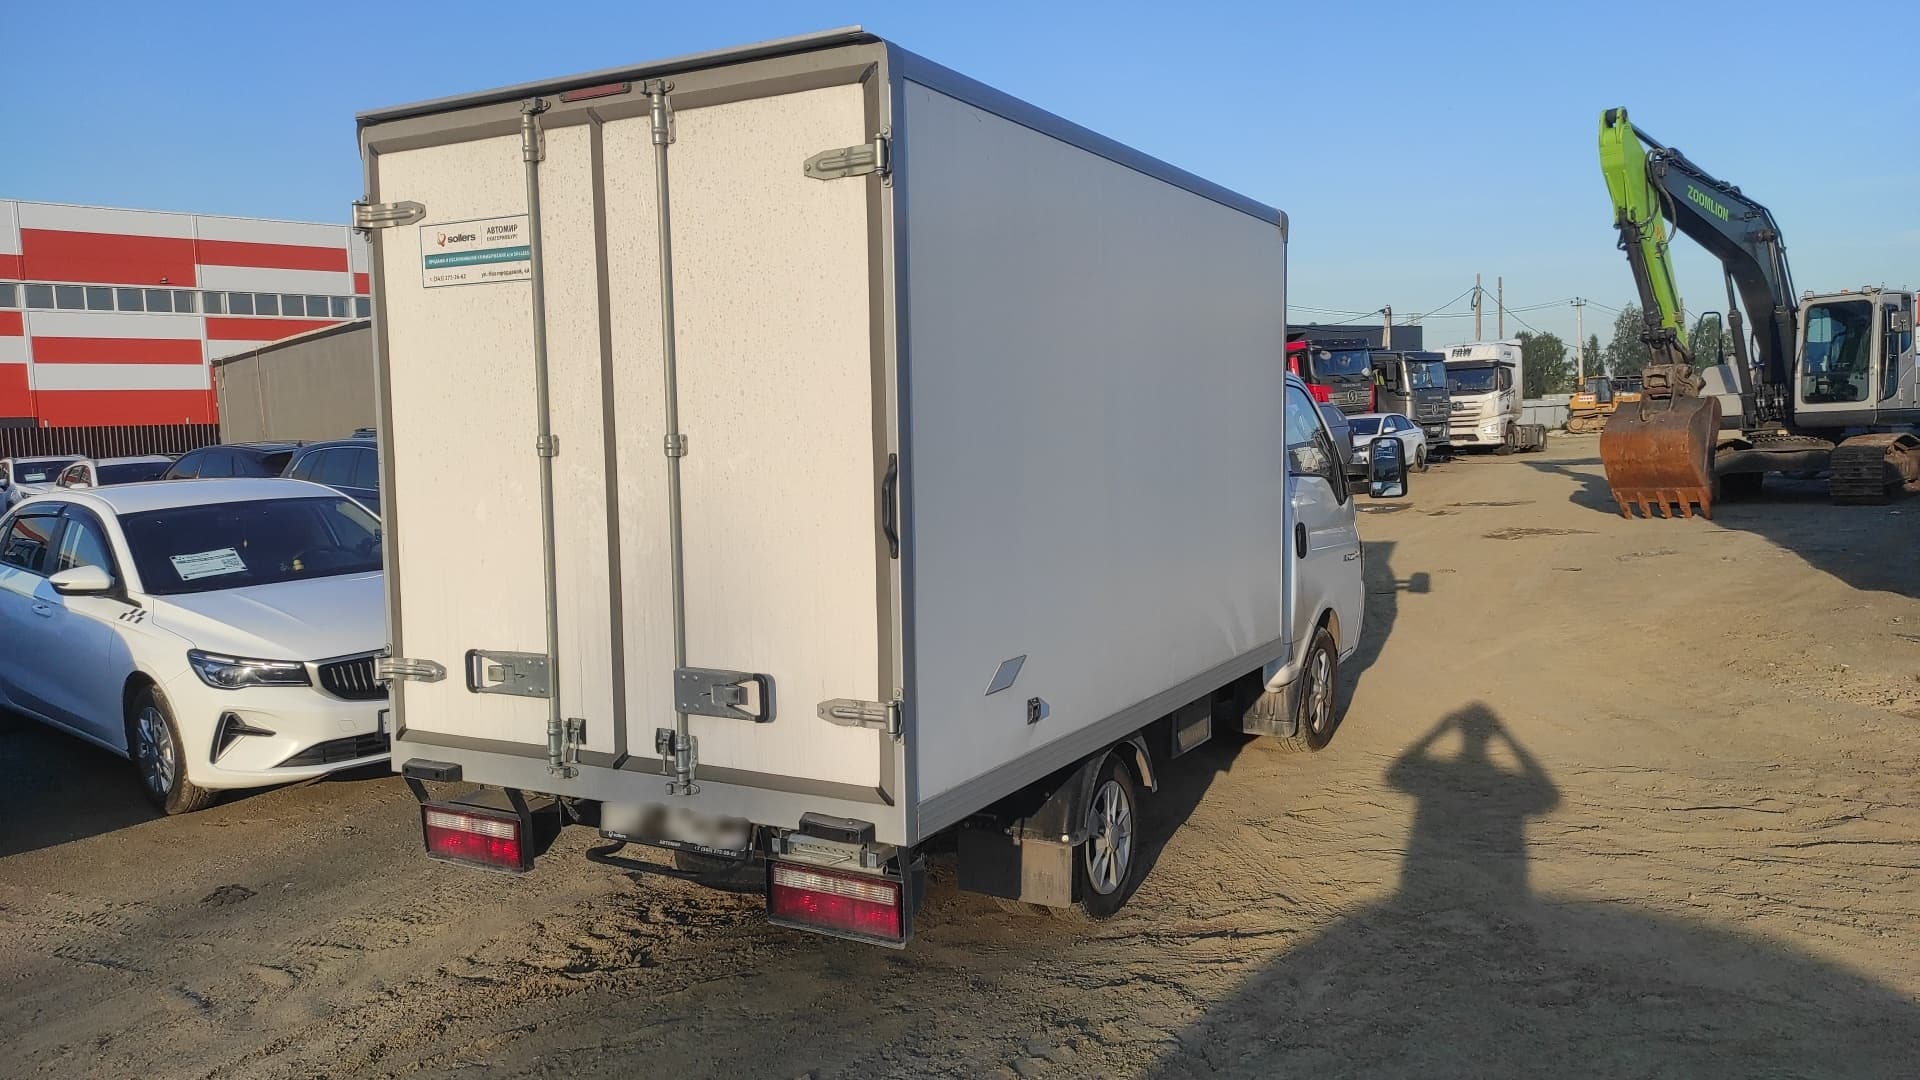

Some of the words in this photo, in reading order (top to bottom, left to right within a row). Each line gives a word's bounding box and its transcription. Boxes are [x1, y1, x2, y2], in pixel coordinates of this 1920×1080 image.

[1687, 184, 1729, 222] ZOOMLION
[487, 224, 518, 235] АВТОМИР
[447, 232, 476, 244] sollers
